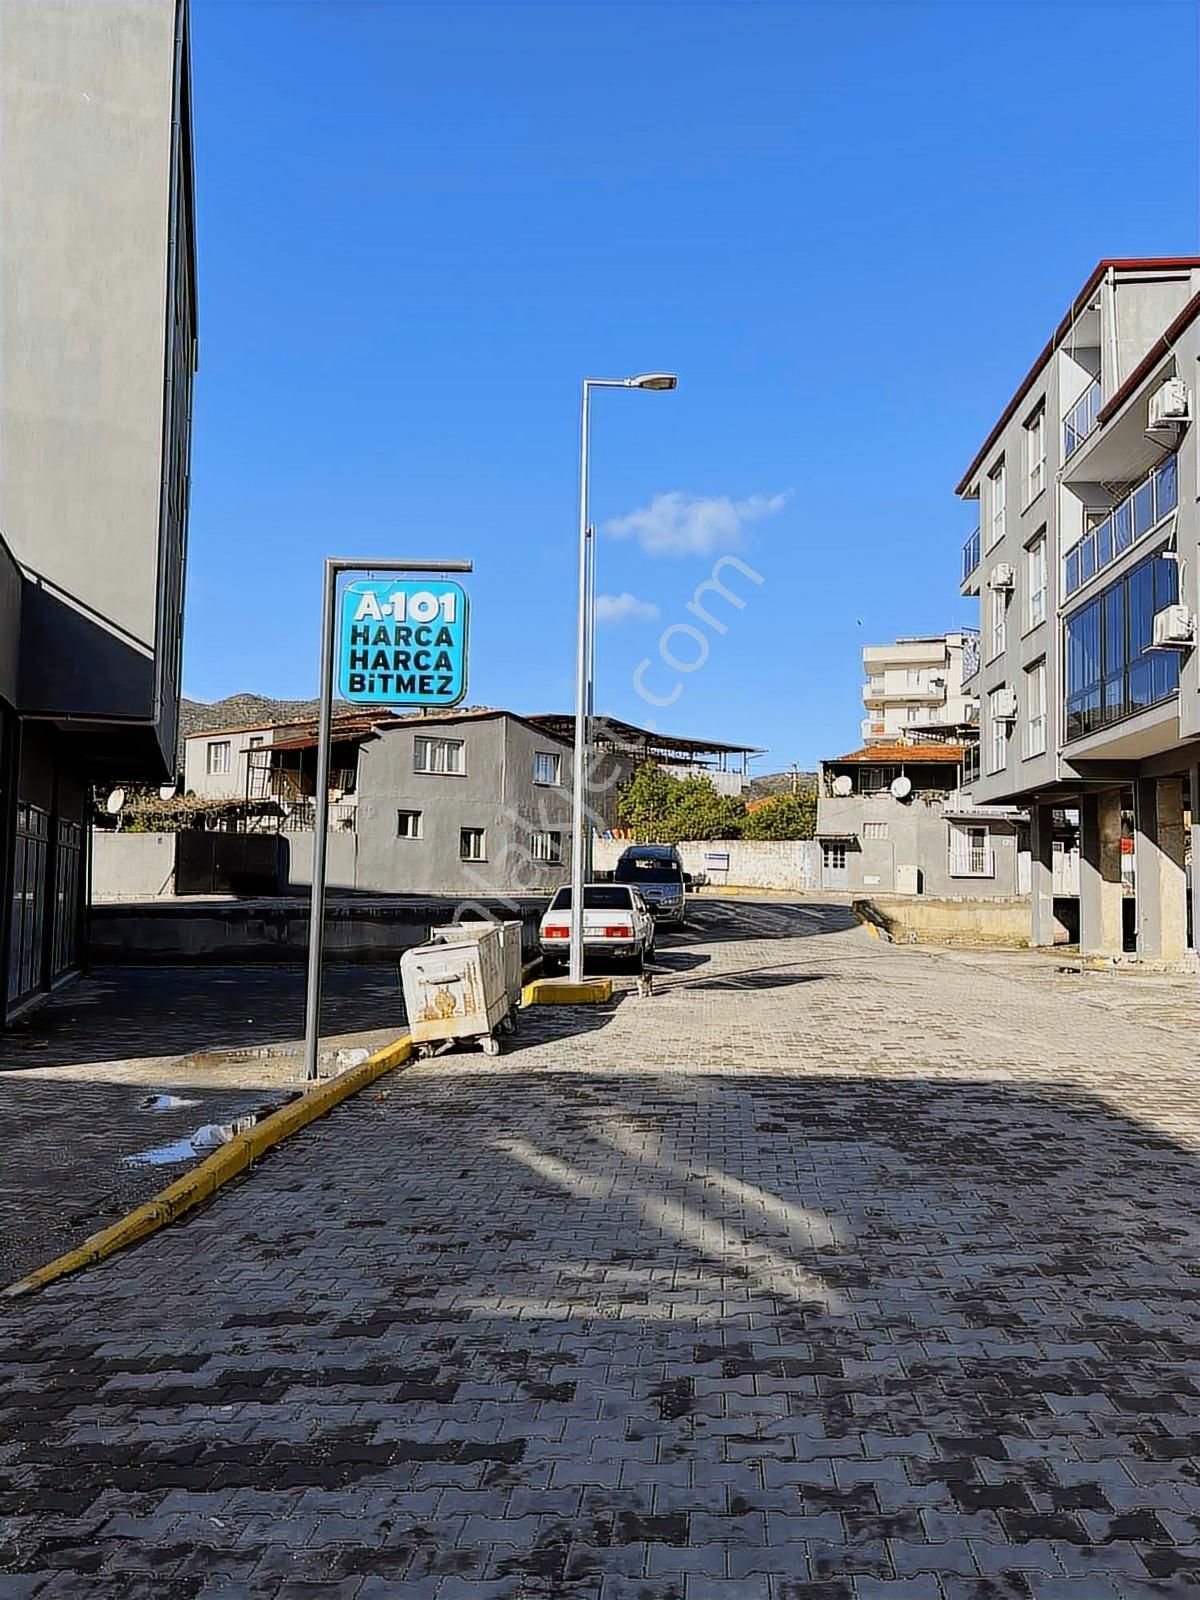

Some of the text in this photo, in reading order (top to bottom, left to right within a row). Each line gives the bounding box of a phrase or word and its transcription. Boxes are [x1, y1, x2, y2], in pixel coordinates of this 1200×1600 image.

[351, 625, 453, 647] HARCA
[350, 649, 453, 671] HARCA
[349, 673, 452, 694] BiTMEZ
